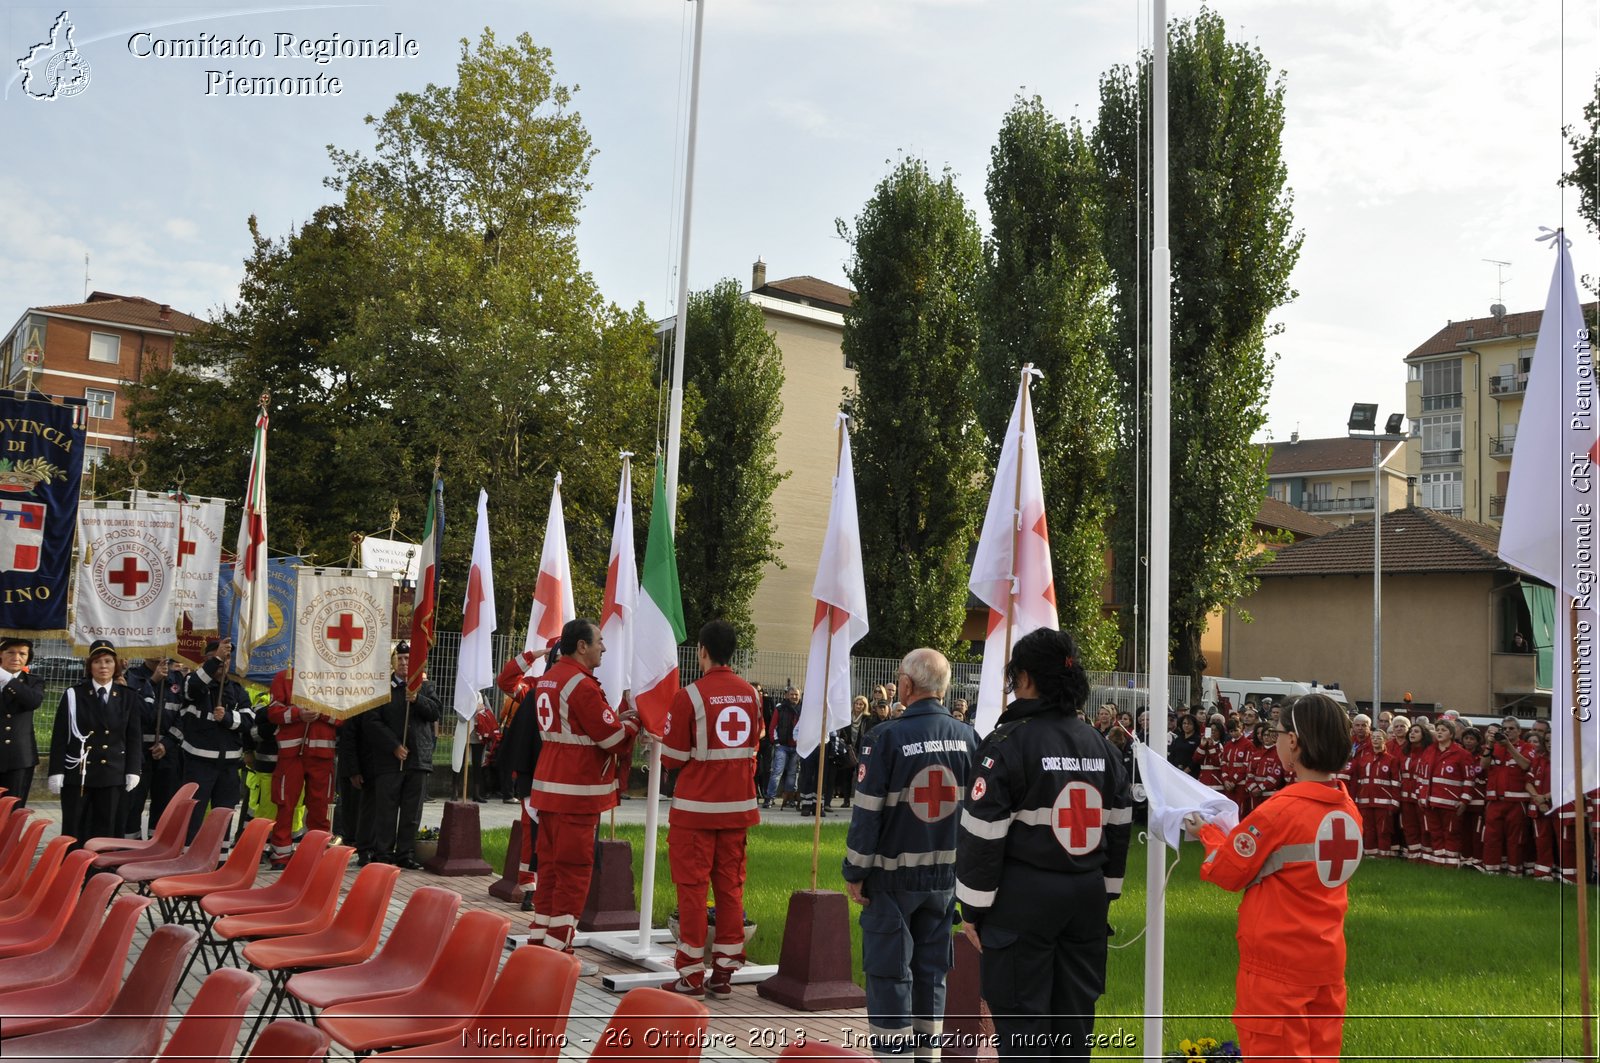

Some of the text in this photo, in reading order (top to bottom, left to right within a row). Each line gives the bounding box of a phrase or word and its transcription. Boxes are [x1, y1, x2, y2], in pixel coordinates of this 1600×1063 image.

[7, 440, 27, 452] DI
[82, 518, 101, 526] CORPO
[103, 519, 135, 527] VOLONTARI
[104, 528, 141, 543] ROSSA
[142, 532, 176, 570] ITALIANA
[105, 549, 115, 558] DI
[116, 543, 150, 558] GINEVRA
[150, 557, 159, 568] 22
[180, 572, 213, 580] LOCALE
[299, 586, 389, 628] CROCE ROSSA ITALIANA
[323, 605, 333, 615] DI
[334, 601, 366, 615] GINEVRA
[364, 613, 374, 624] 22
[81, 625, 153, 636] CASTAGNOLE
[313, 614, 338, 664] CONVENZIONE
[298, 671, 386, 680] COMITATO LOCALE
[307, 685, 376, 697] CARIGNANO
[709, 695, 724, 705] CROCE
[723, 695, 736, 704] ROSSA
[902, 739, 968, 757] CROCE ROSSA ITALIANA
[1041, 756, 1106, 772] CROCE ROSSA ITALIANA
